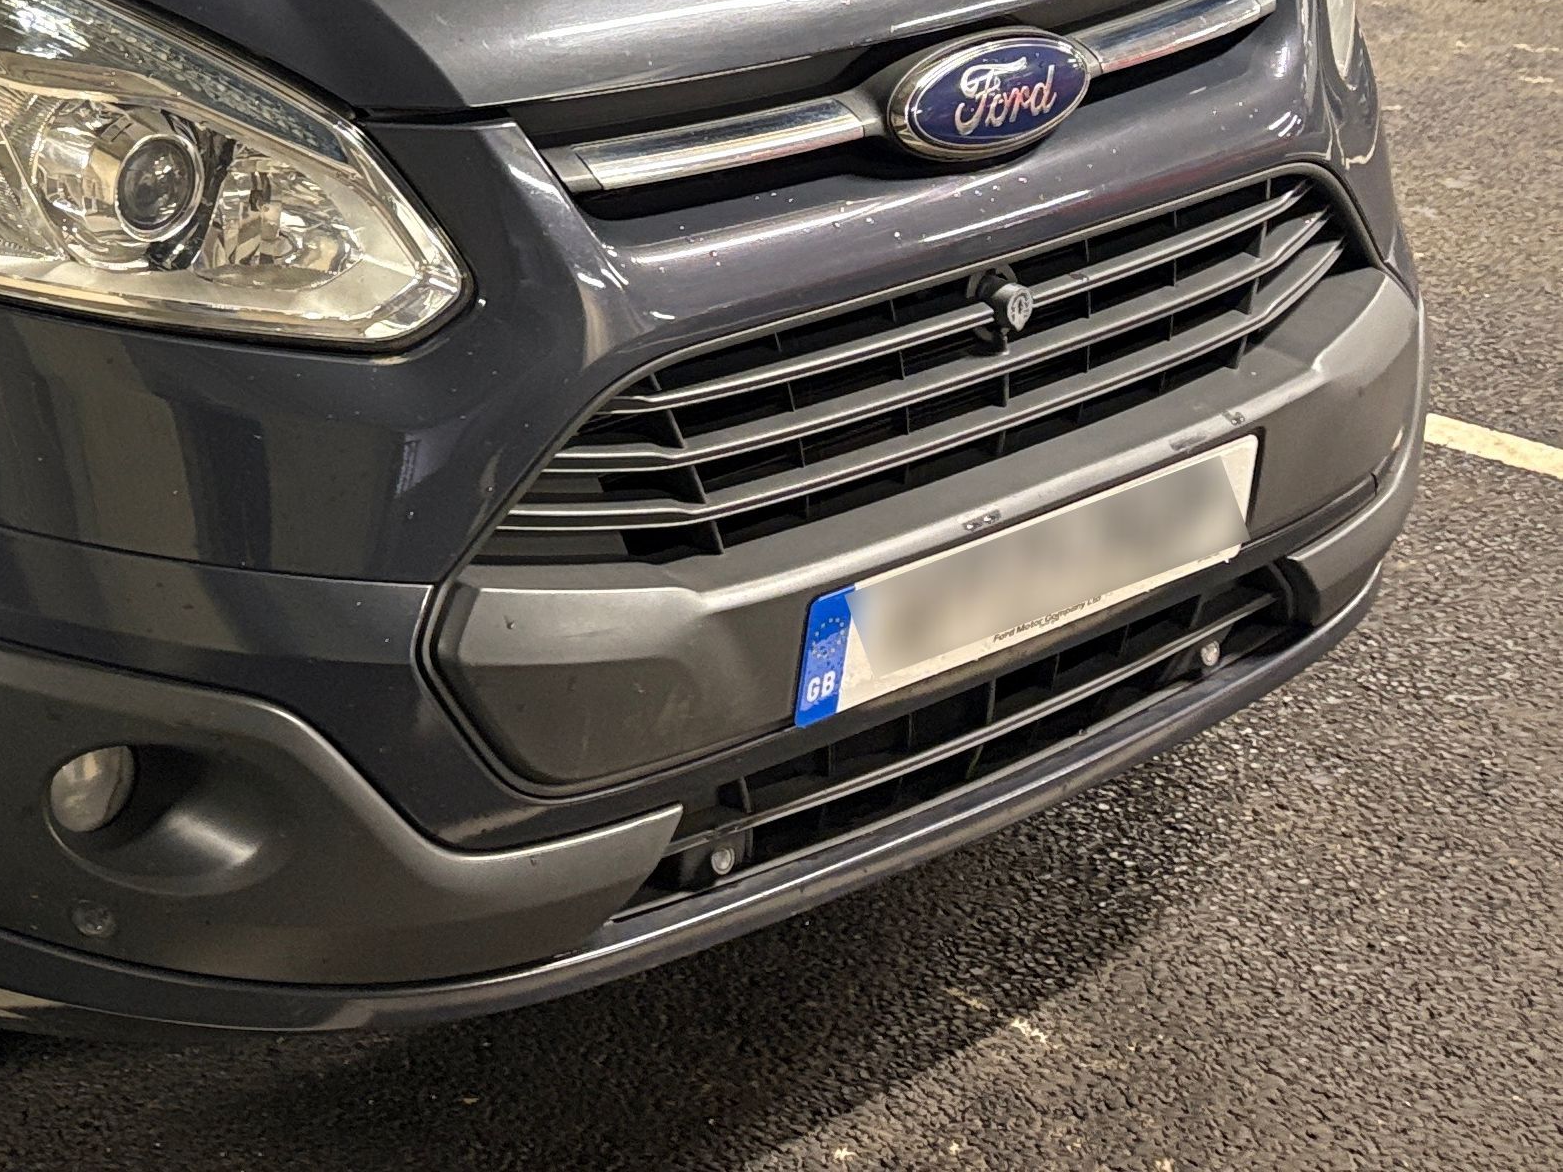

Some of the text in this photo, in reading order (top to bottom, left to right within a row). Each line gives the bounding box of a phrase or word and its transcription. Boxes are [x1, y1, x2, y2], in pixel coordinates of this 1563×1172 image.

[955, 57, 1057, 135] Ford
[993, 595, 1102, 643] Ford Motor Company Ltd
[807, 670, 836, 703] GB
